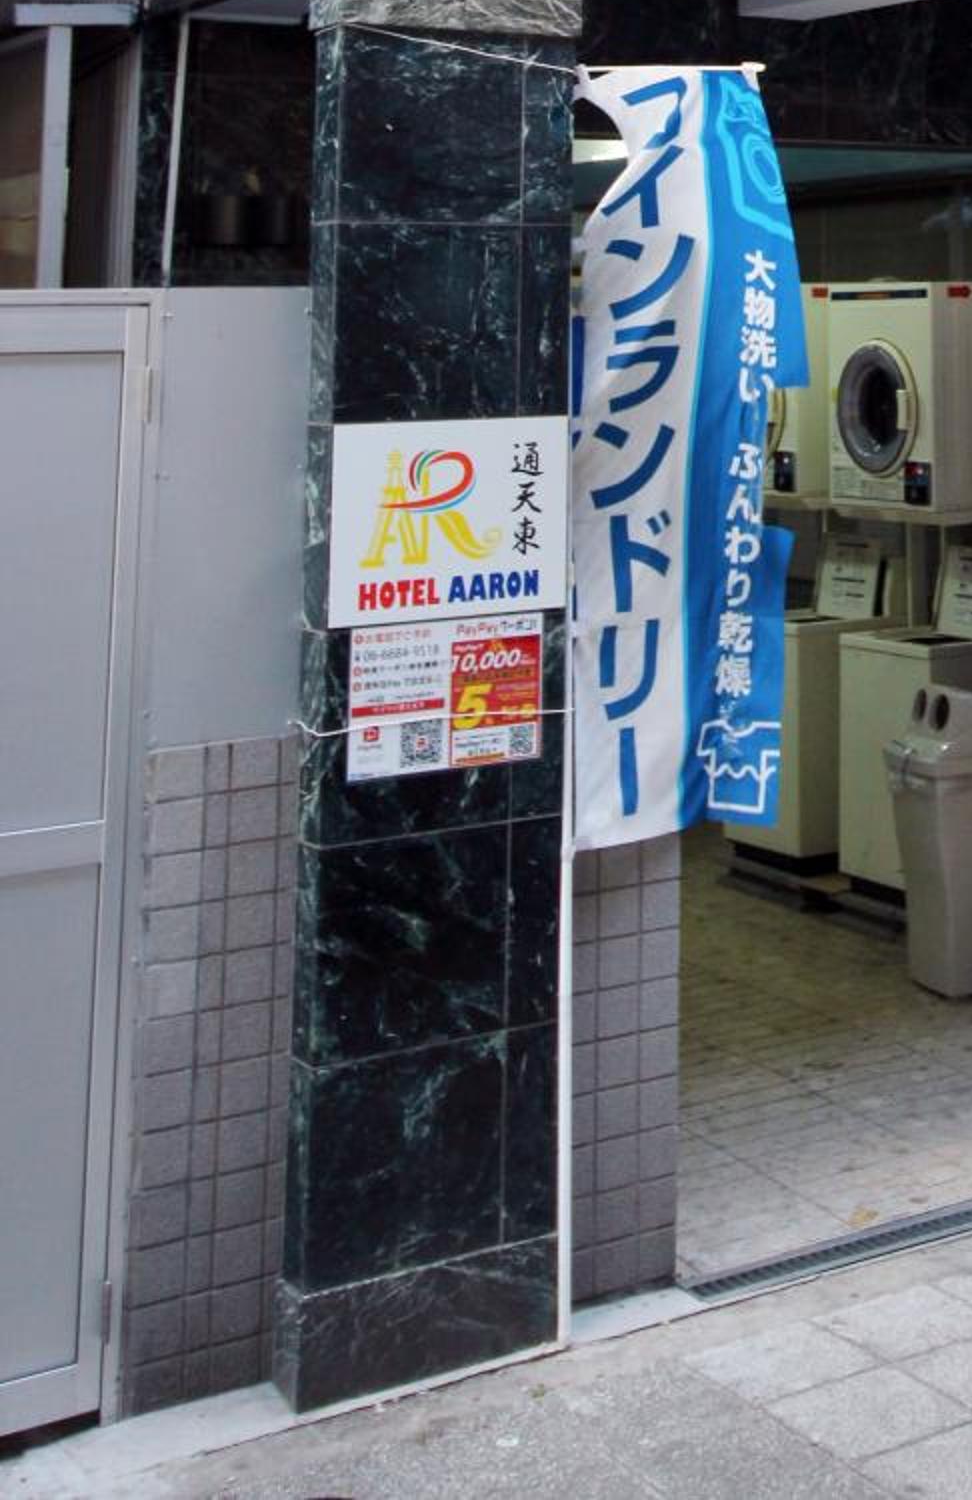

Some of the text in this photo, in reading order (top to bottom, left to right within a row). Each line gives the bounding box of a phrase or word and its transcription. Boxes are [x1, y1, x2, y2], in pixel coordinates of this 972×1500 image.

[714, 250, 777, 697] 大物洗い ふんわり乾燥
[358, 570, 540, 610] HOTEL AARON
[451, 648, 521, 674] 10,000
[452, 683, 493, 730] 5
